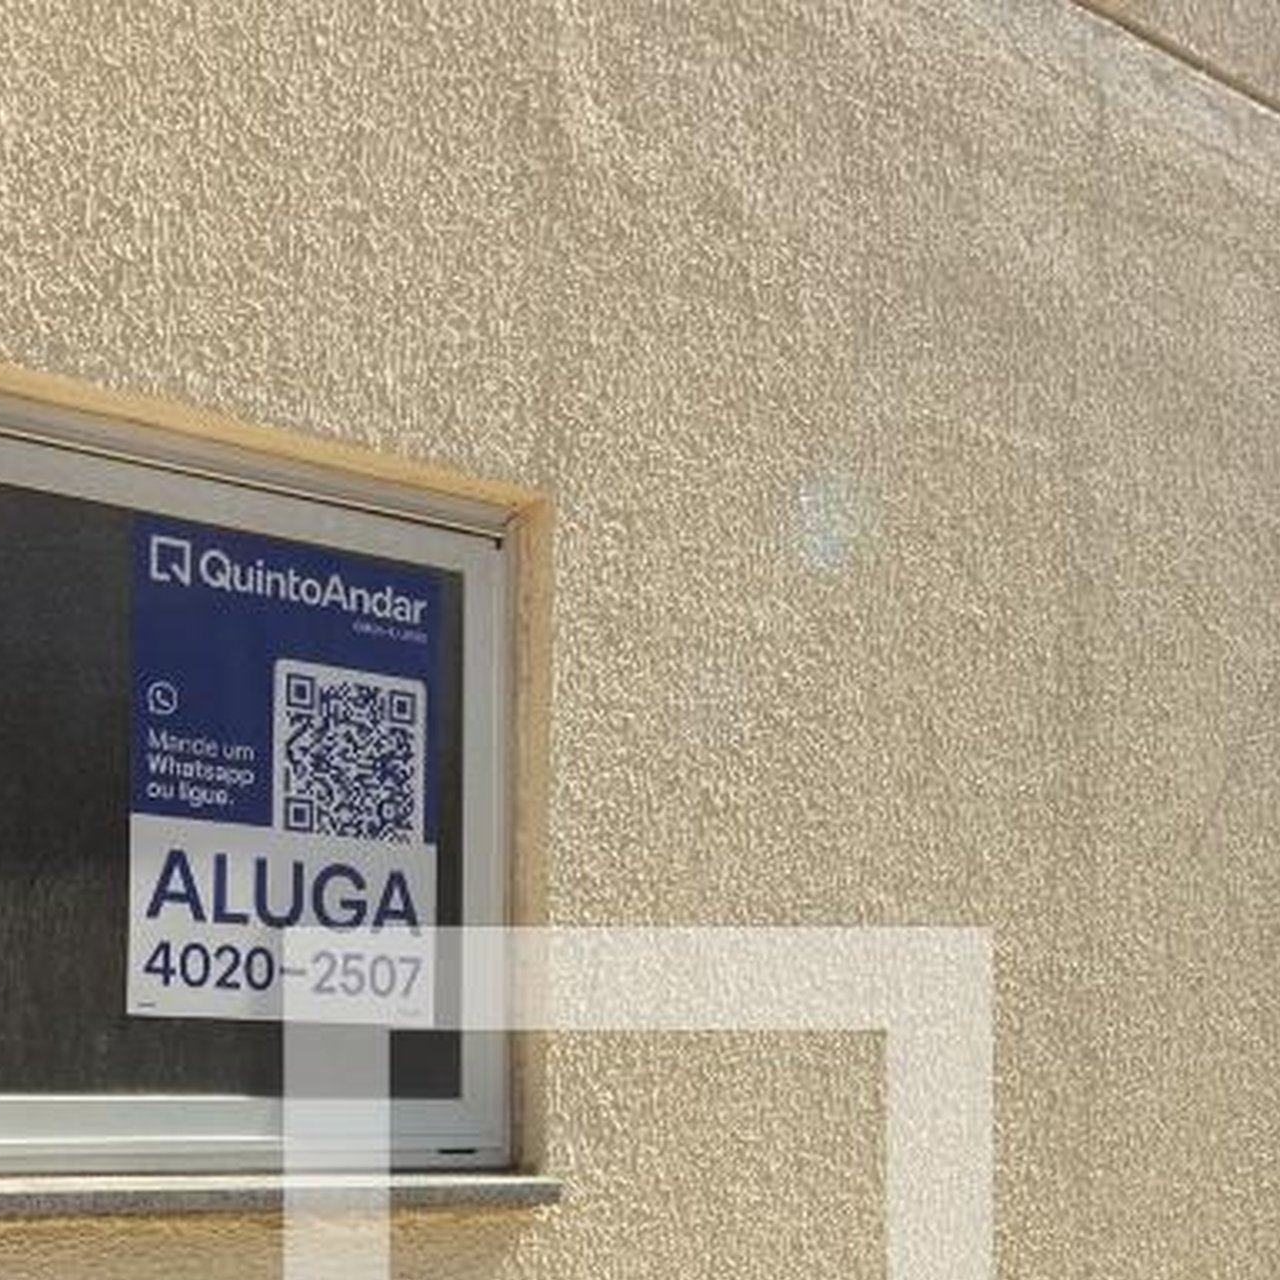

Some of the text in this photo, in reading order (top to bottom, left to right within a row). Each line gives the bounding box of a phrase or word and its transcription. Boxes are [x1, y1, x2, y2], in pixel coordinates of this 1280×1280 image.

[201, 550, 428, 625] QuintoAndar
[222, 745, 255, 761] um
[147, 782, 174, 799] ou
[146, 849, 422, 936] ALUGA
[143, 940, 423, 999] 4020-2507
